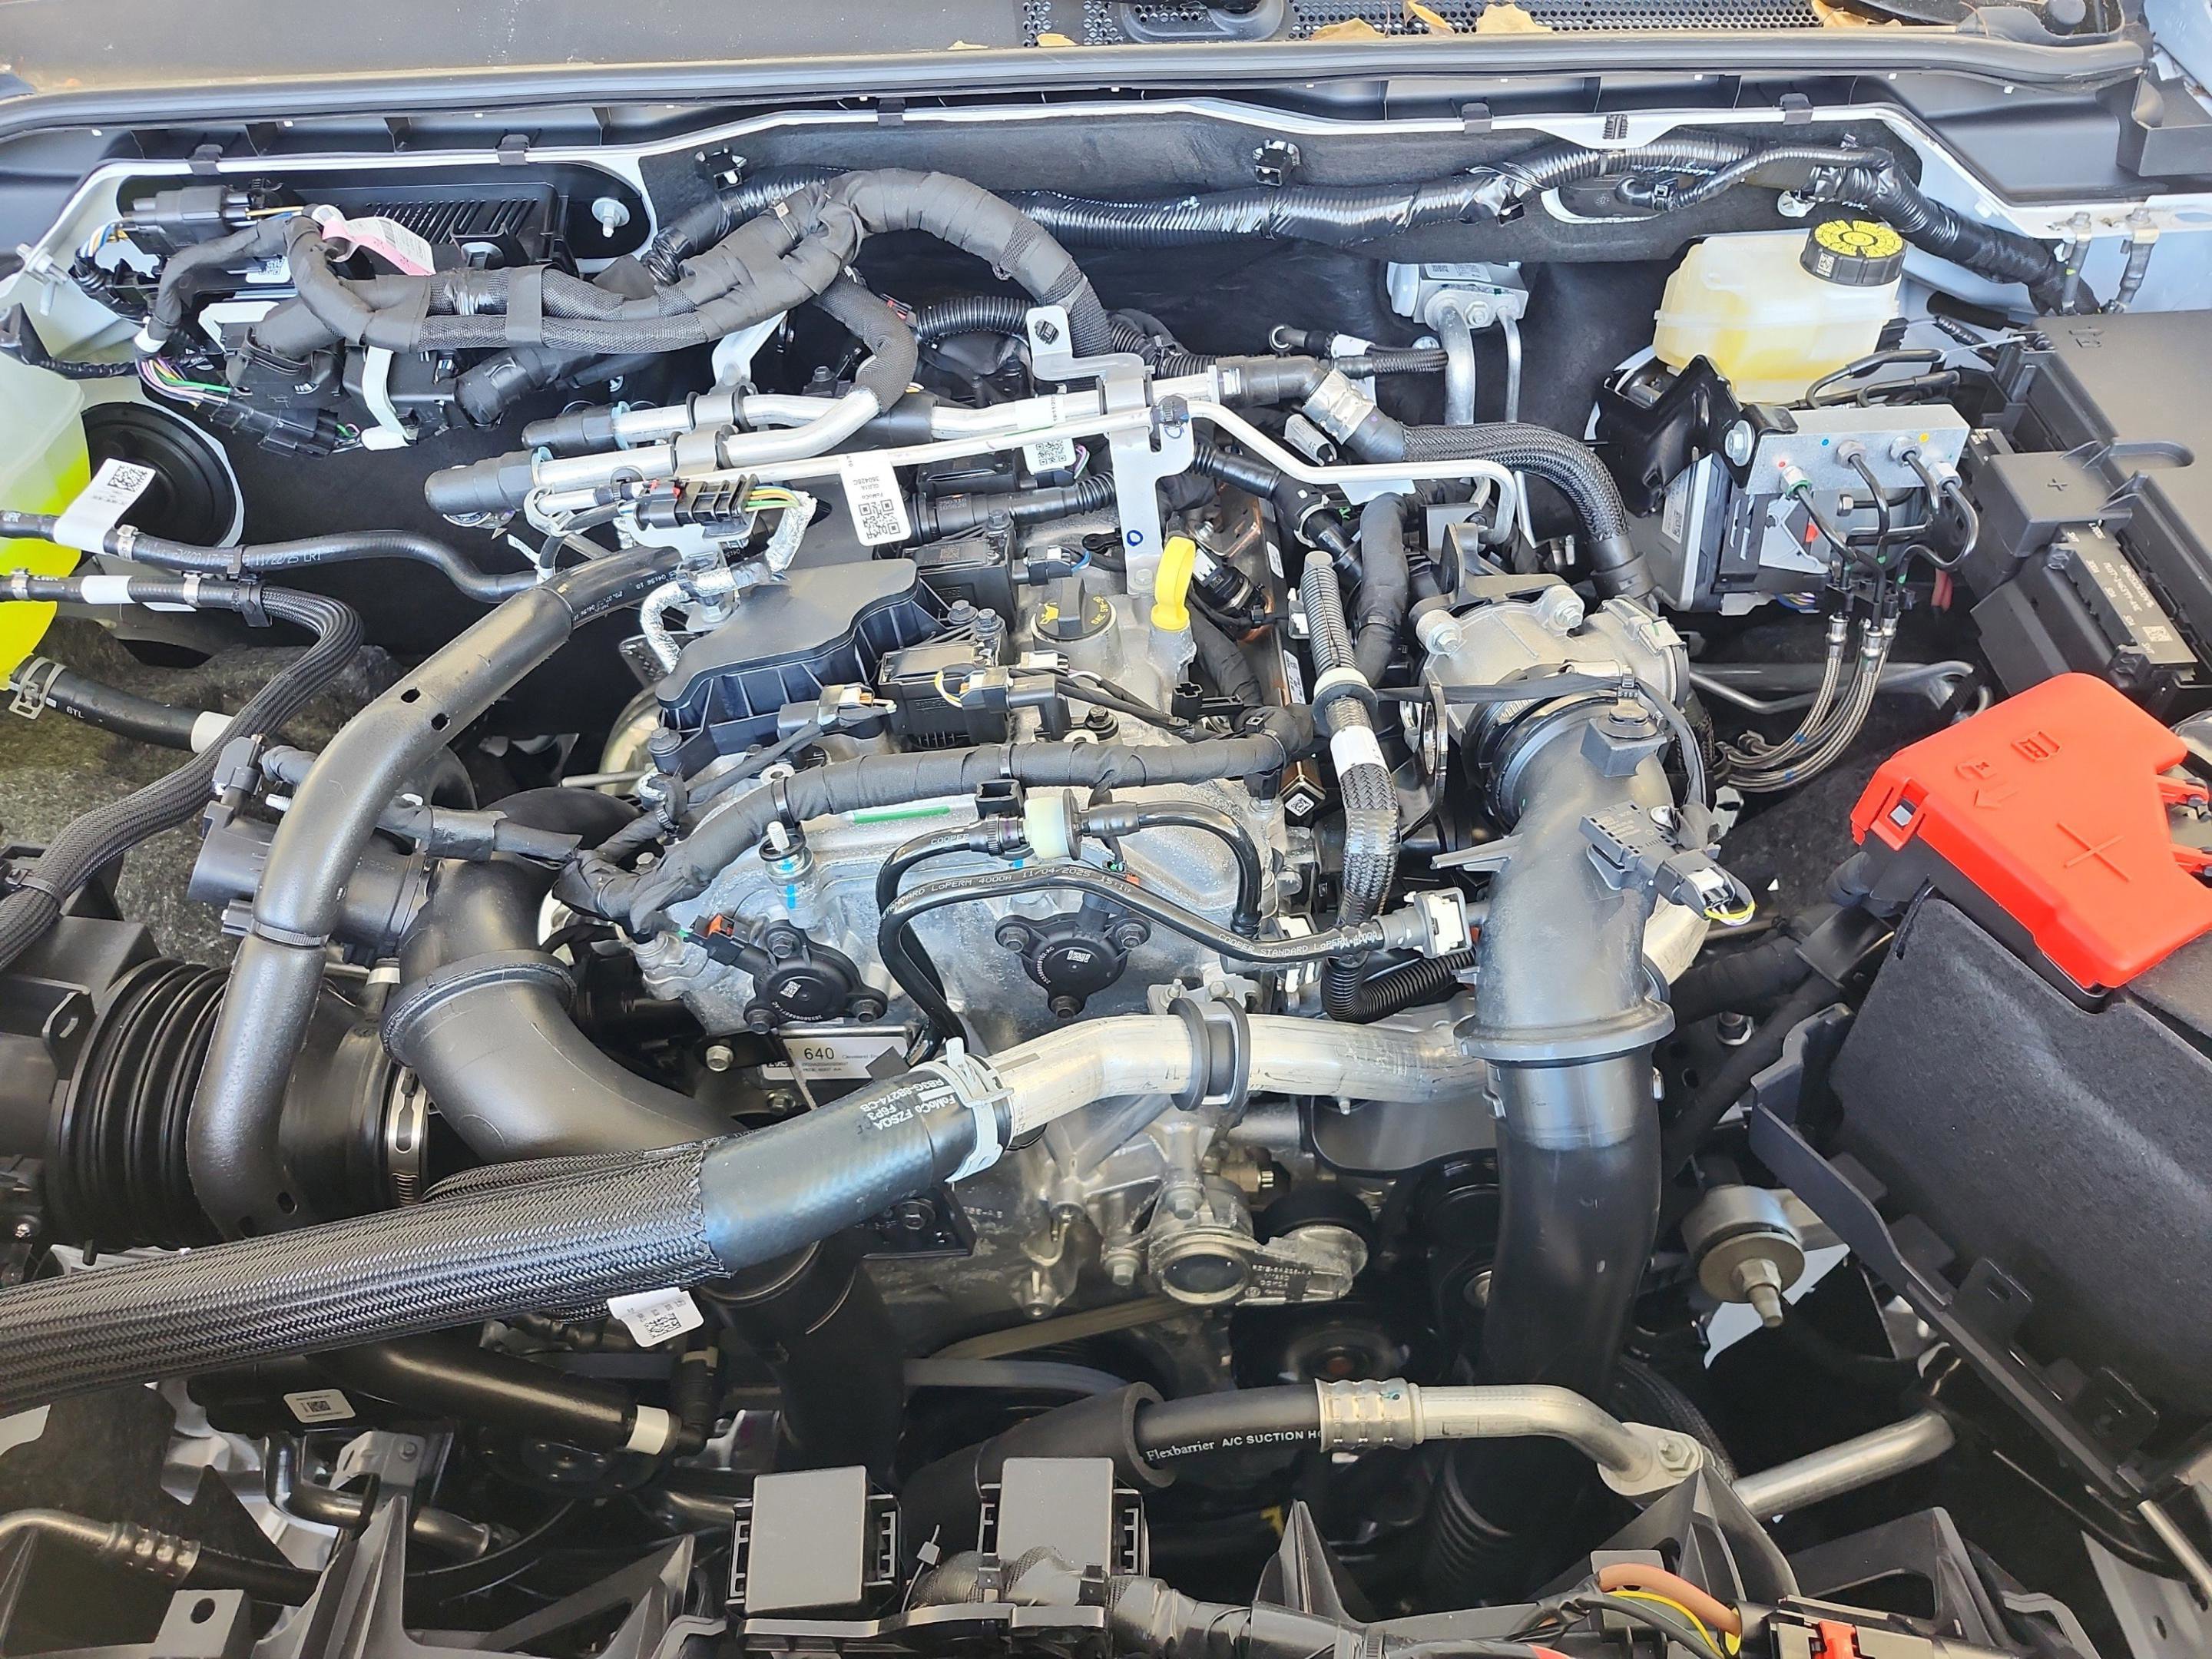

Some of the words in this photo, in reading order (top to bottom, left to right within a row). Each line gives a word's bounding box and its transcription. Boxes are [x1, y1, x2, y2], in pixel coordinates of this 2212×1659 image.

[1091, 614, 1106, 625] SAE
[930, 833, 969, 846] COOPER
[1022, 867, 1091, 879] 11/04/2025
[1218, 932, 1255, 954] COOPER
[1260, 945, 1309, 957] STANDARD
[804, 1047, 835, 1060] 640
[859, 1078, 945, 1112] RB3G-8B274-CB
[866, 1104, 897, 1121] F6P3
[914, 1094, 957, 1114] FoMoCo
[1146, 1440, 1215, 1462] Flexbarrier
[1222, 1436, 1243, 1447] A/C
[1246, 1430, 1304, 1445] SUCTION
